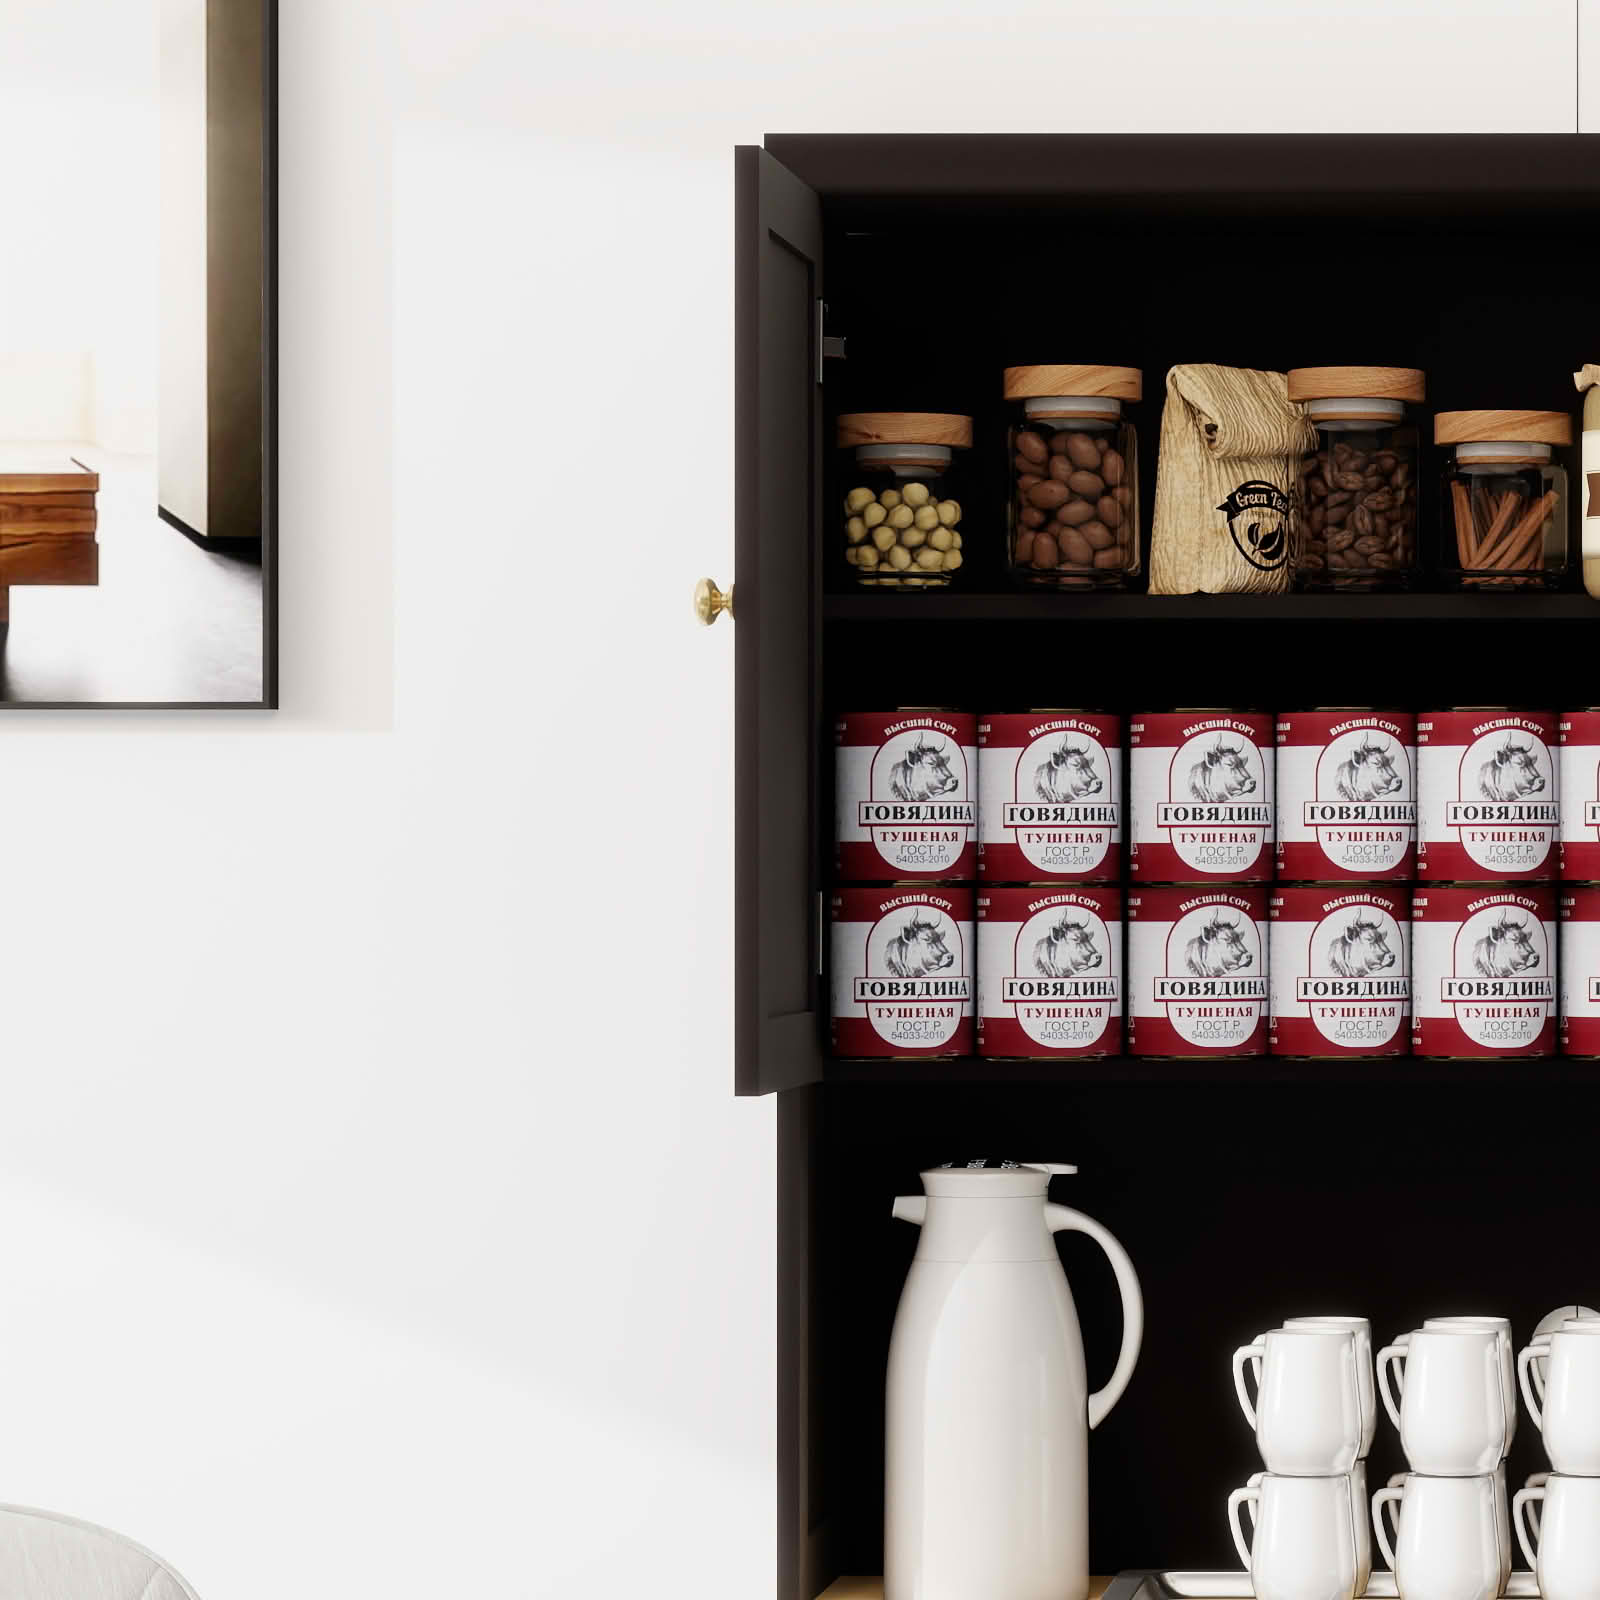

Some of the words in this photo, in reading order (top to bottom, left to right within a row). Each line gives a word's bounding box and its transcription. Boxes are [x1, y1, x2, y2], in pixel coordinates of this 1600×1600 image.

[1236, 493, 1268, 507] Green
[883, 717, 932, 736] ВЫСШИЙ
[933, 720, 958, 735] СОРТ
[1182, 718, 1231, 737] ВЫСШИЙ
[1232, 721, 1256, 736] СОРТ
[1472, 717, 1521, 736] ВЫСШИЙ
[1522, 720, 1544, 735] СОРТ
[865, 805, 972, 822] ГОВЯДИНА
[1009, 807, 1116, 824] ГОВЯДИНА
[1163, 807, 1270, 824] ГОВЯДИНА
[1310, 805, 1417, 822] ГОВЯДИНА
[1454, 806, 1558, 823] ГОВЯДИНА
[878, 831, 959, 842] ТУШЕНАЯ
[1024, 833, 1103, 844] ТУШЕНАЯ
[1178, 833, 1257, 844] ТУШЕНАЯ
[1326, 832, 1403, 843] ТУШЕНАЯ
[1469, 832, 1546, 843] ТУШЕНАЯ
[1046, 846, 1079, 857] ГОСТ
[1347, 845, 1380, 856] ГОСТ
[1041, 857, 1094, 865] 54033-2010
[1343, 856, 1394, 864] 54033-2010
[1028, 893, 1077, 912] ВЫСШИЙ
[1078, 896, 1101, 911] СОРТ
[1322, 893, 1371, 912] ВЫСШИЙ
[1372, 896, 1394, 911] СОРТ
[860, 981, 967, 998] ГОВЯДИНА
[1009, 982, 1116, 999] ГОВЯДИНА
[1160, 981, 1267, 998] ГОВЯДИНА
[1304, 981, 1408, 998] ГОВЯДИНА
[1449, 982, 1553, 999] ГОВЯДИНА
[875, 1008, 954, 1019] ТУШЕНАЯ
[1024, 1008, 1103, 1019] ТУШЕНАЯ
[1176, 1007, 1253, 1018] ТУШЕНАЯ
[1319, 1007, 1396, 1018] ТУШЕНАЯ
[1464, 1008, 1541, 1019] ТУШЕНАЯ
[1485, 1021, 1517, 1032] ГОСТ
[1480, 1032, 1531, 1040] 54033-2010
